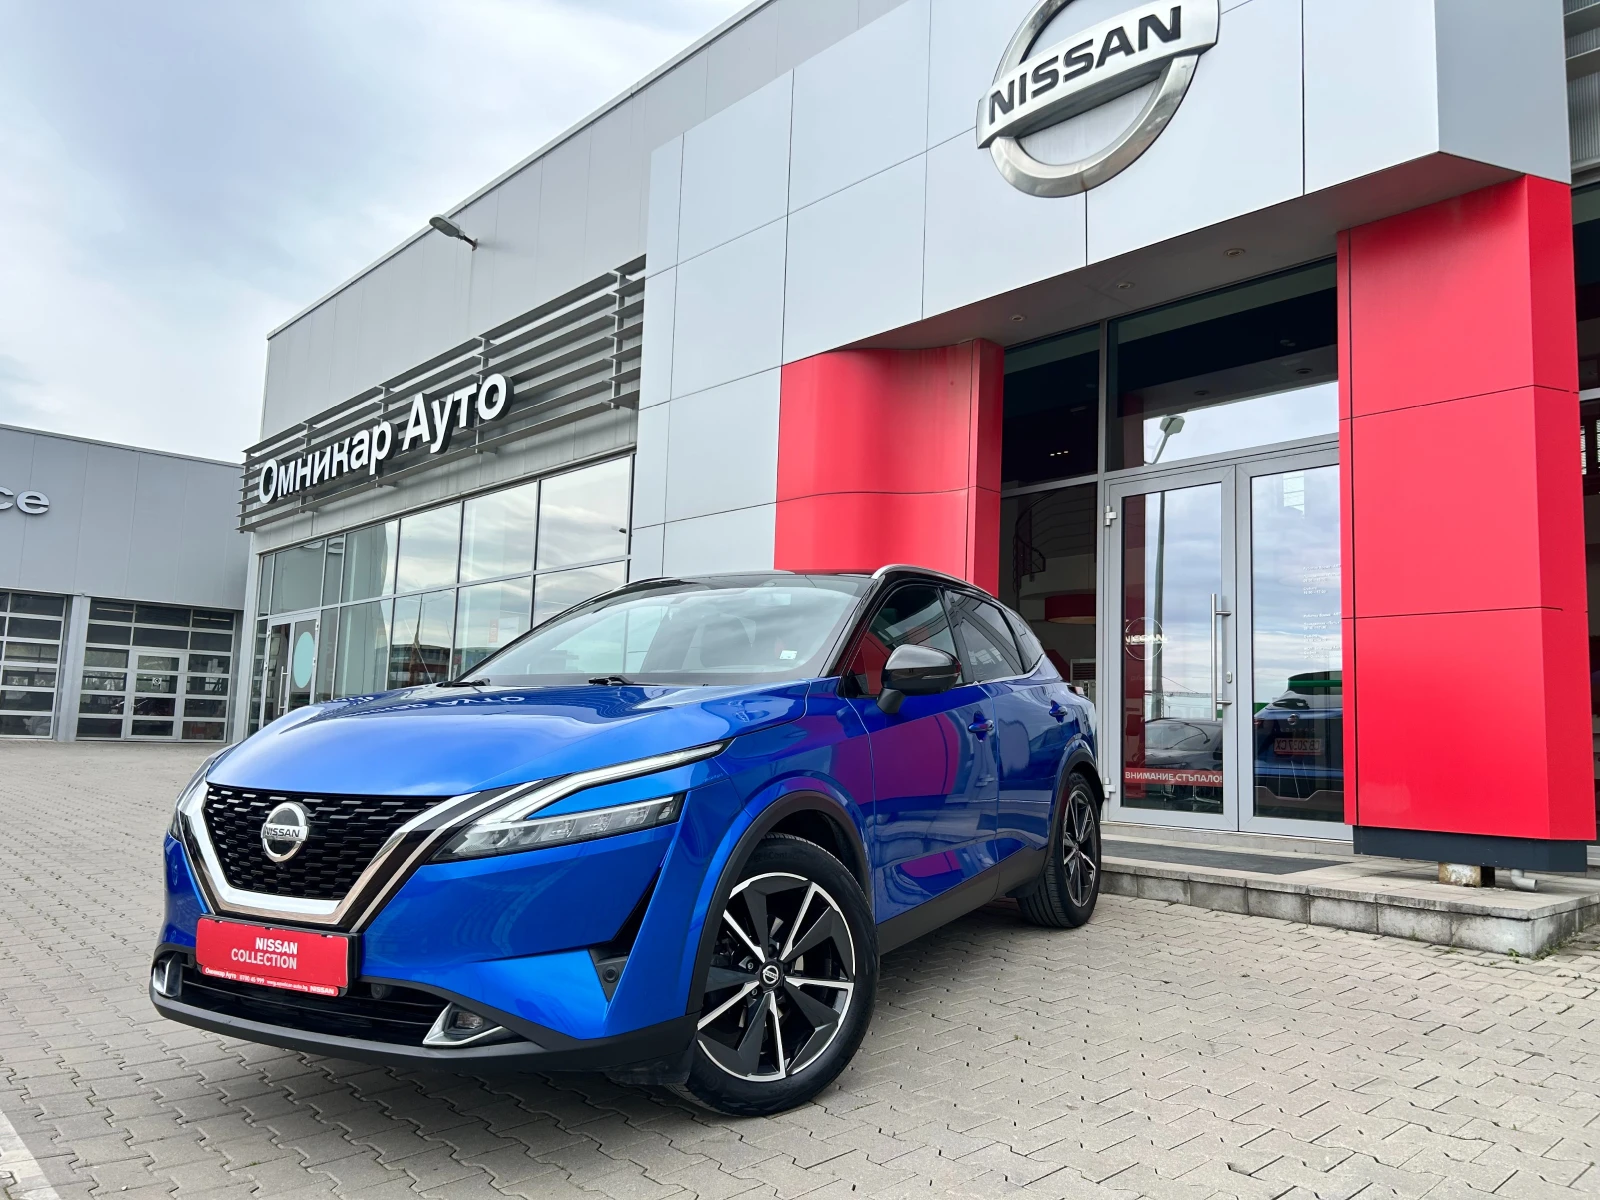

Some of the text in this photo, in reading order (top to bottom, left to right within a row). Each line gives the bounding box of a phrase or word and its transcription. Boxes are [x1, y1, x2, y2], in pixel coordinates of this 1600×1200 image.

[989, 5, 1182, 126] NISSAN
[258, 373, 509, 504] Омникар Ауто
[1125, 771, 1174, 781] ВНИМАНИЕ
[265, 827, 301, 838] NISSAN
[255, 937, 298, 954] NISSAN
[231, 948, 297, 970] COLLECTION
[309, 985, 335, 995] NISSAN
